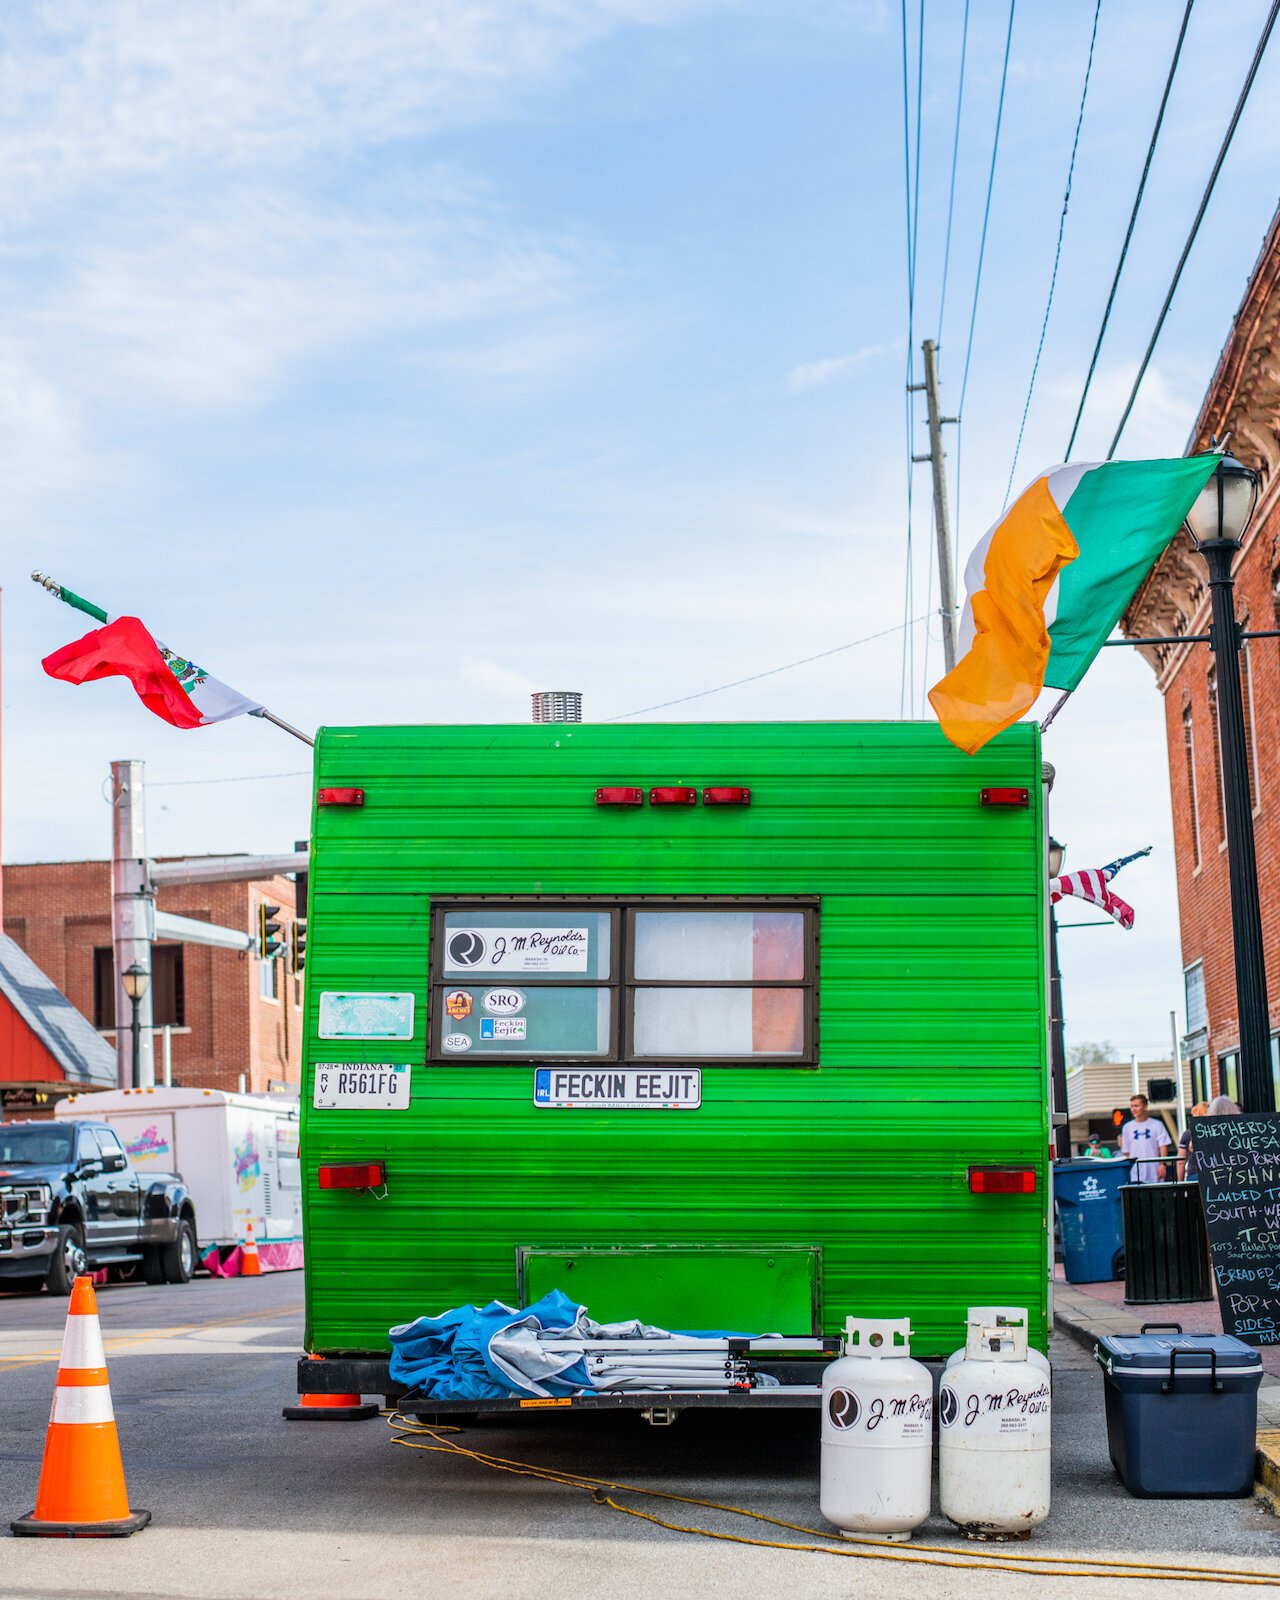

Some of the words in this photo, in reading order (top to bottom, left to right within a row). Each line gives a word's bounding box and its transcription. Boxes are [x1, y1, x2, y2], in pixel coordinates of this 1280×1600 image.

[530, 930, 585, 953] Reynolds
[551, 942, 565, 955] Oil
[489, 994, 518, 1007] SRQ
[494, 1026, 518, 1035] Eejit
[446, 1038, 468, 1046] SEA
[341, 1063, 384, 1071] INDIANA
[338, 1073, 398, 1094] R561FG
[555, 1074, 626, 1098] FECKIN
[635, 1074, 693, 1099] EEJIT
[537, 1089, 550, 1097] IRL
[1194, 1119, 1277, 1139] SHEPHERDS
[1228, 1135, 1280, 1150] QUESA
[1195, 1151, 1249, 1171] PULLED
[1247, 1150, 1280, 1166] PORK
[1206, 1186, 1261, 1202] LOADED
[1214, 1264, 1274, 1287] BREADED
[1028, 1401, 1041, 1414] Oil
